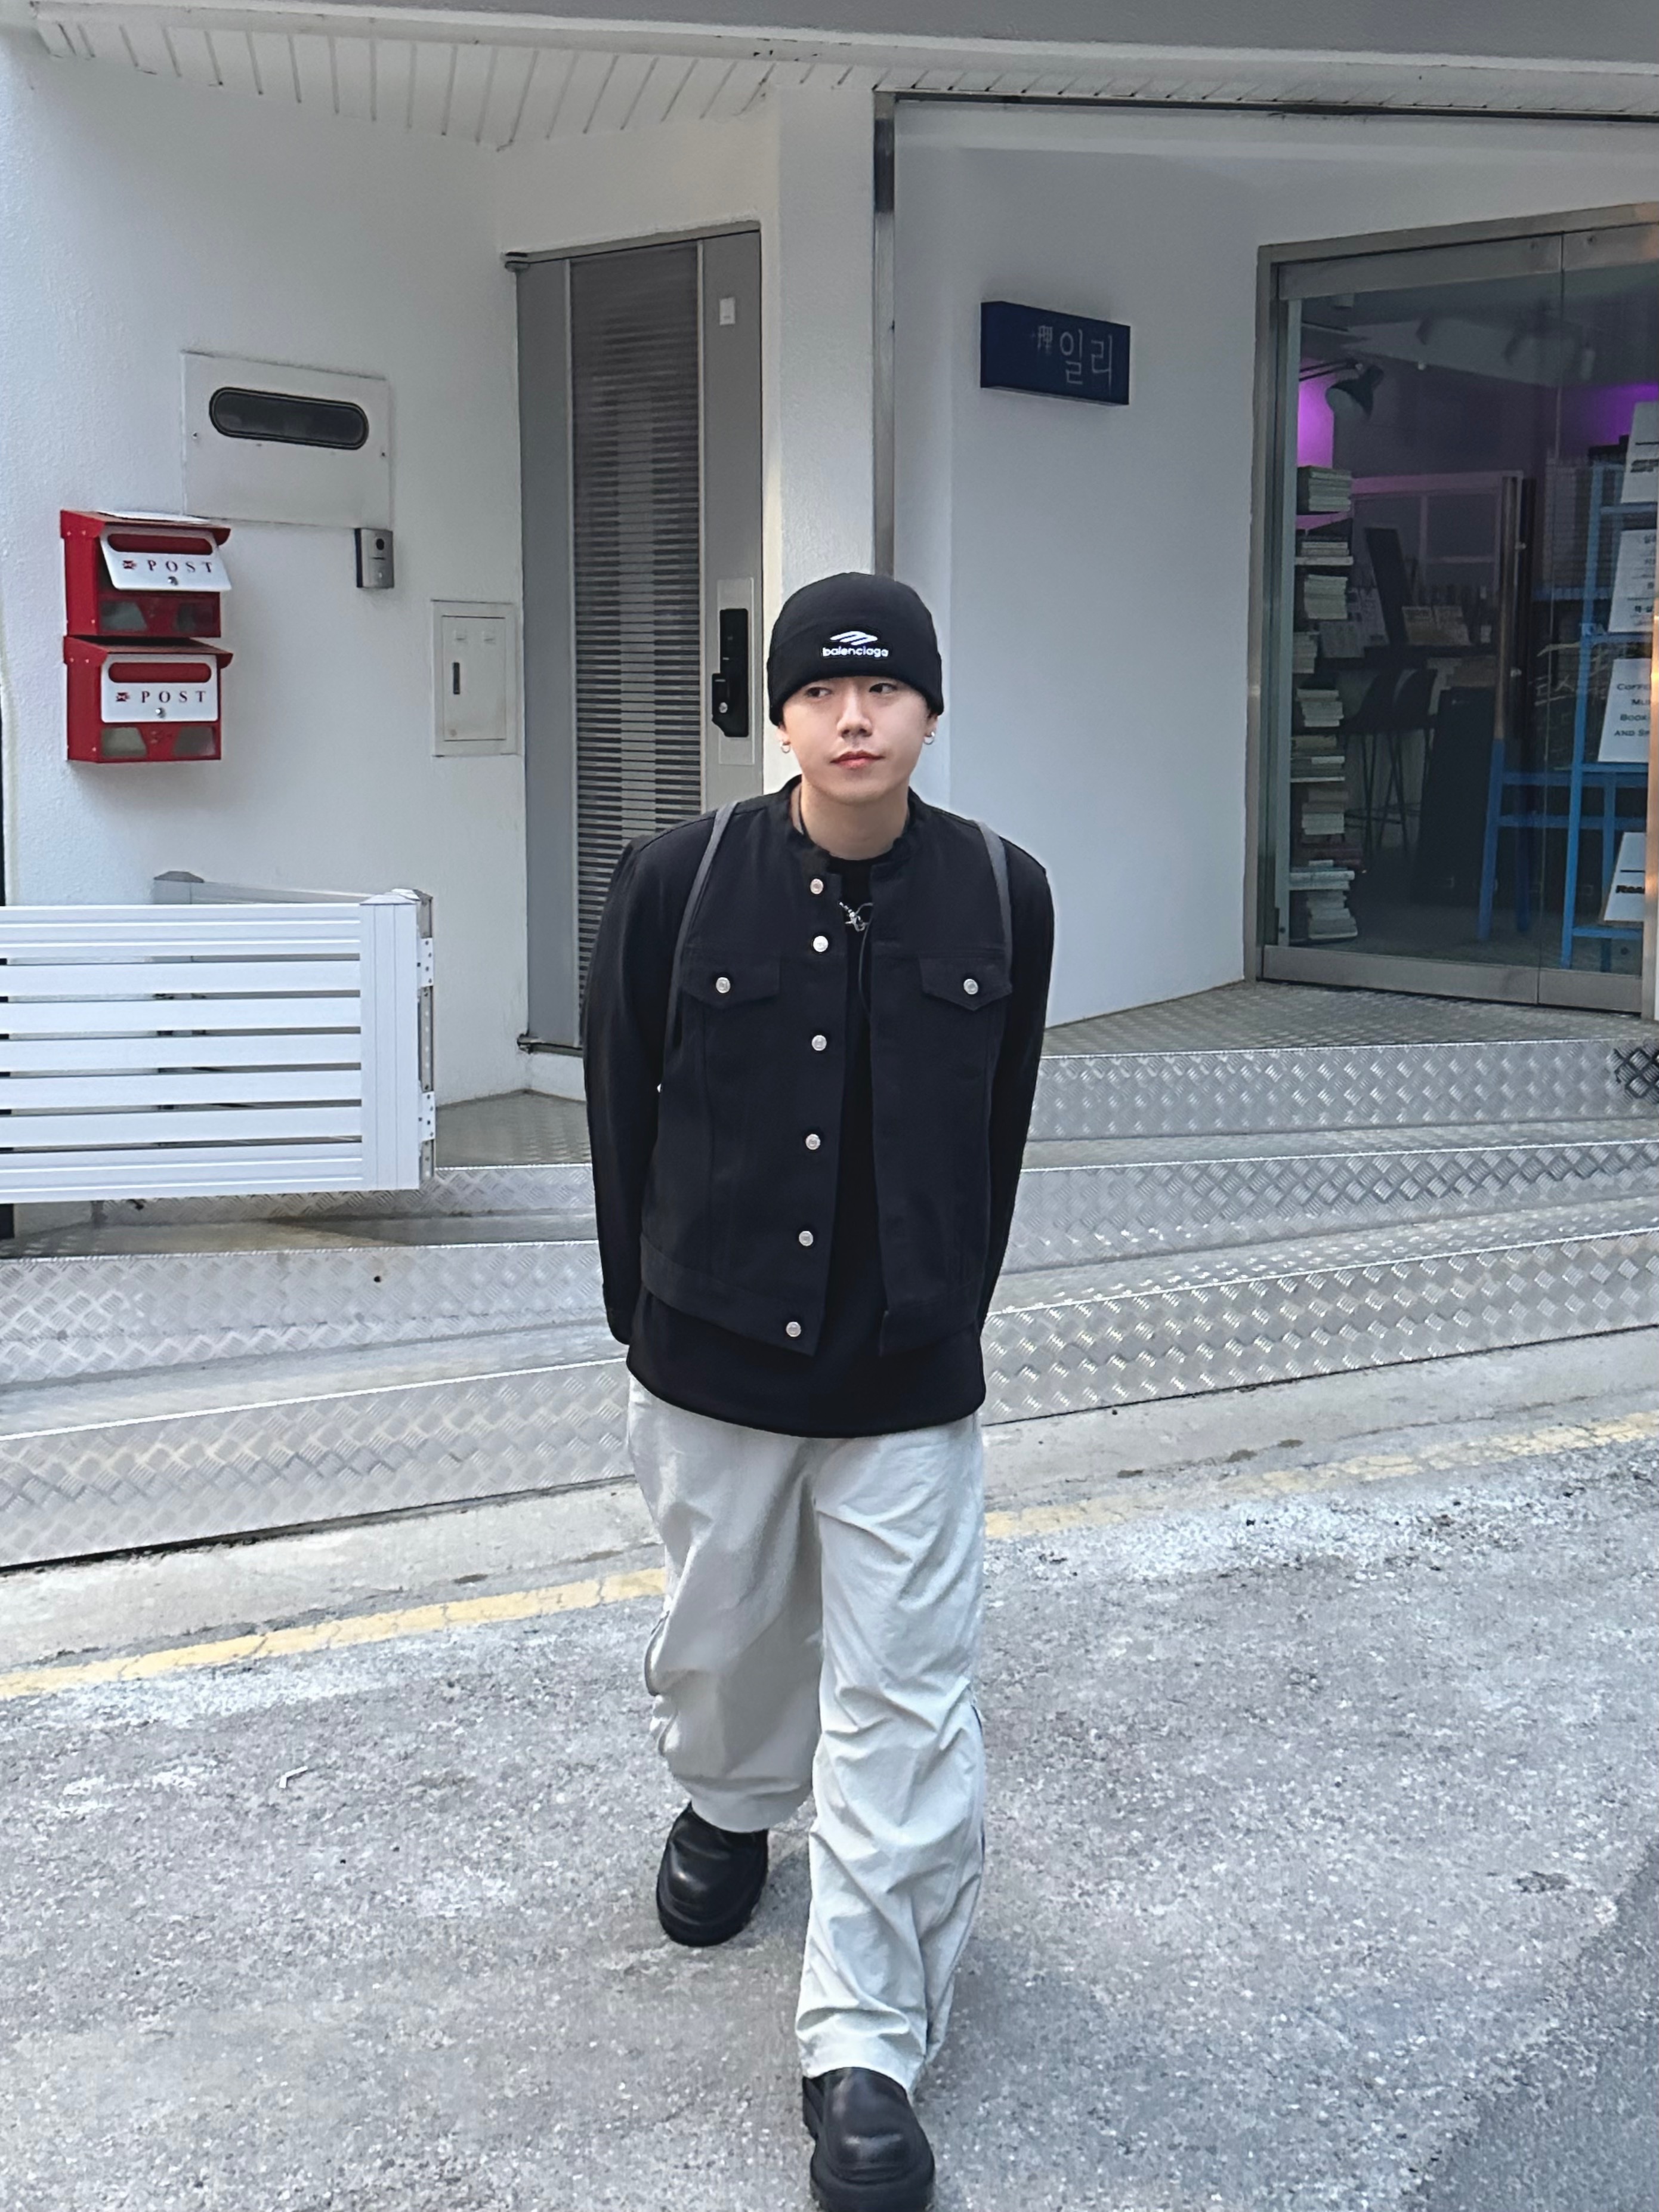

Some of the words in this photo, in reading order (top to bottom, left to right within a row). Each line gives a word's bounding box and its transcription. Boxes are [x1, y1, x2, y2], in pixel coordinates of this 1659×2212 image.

[148, 560, 212, 572] POST
[823, 646, 888, 657] balenciaga
[141, 691, 206, 703] POST
